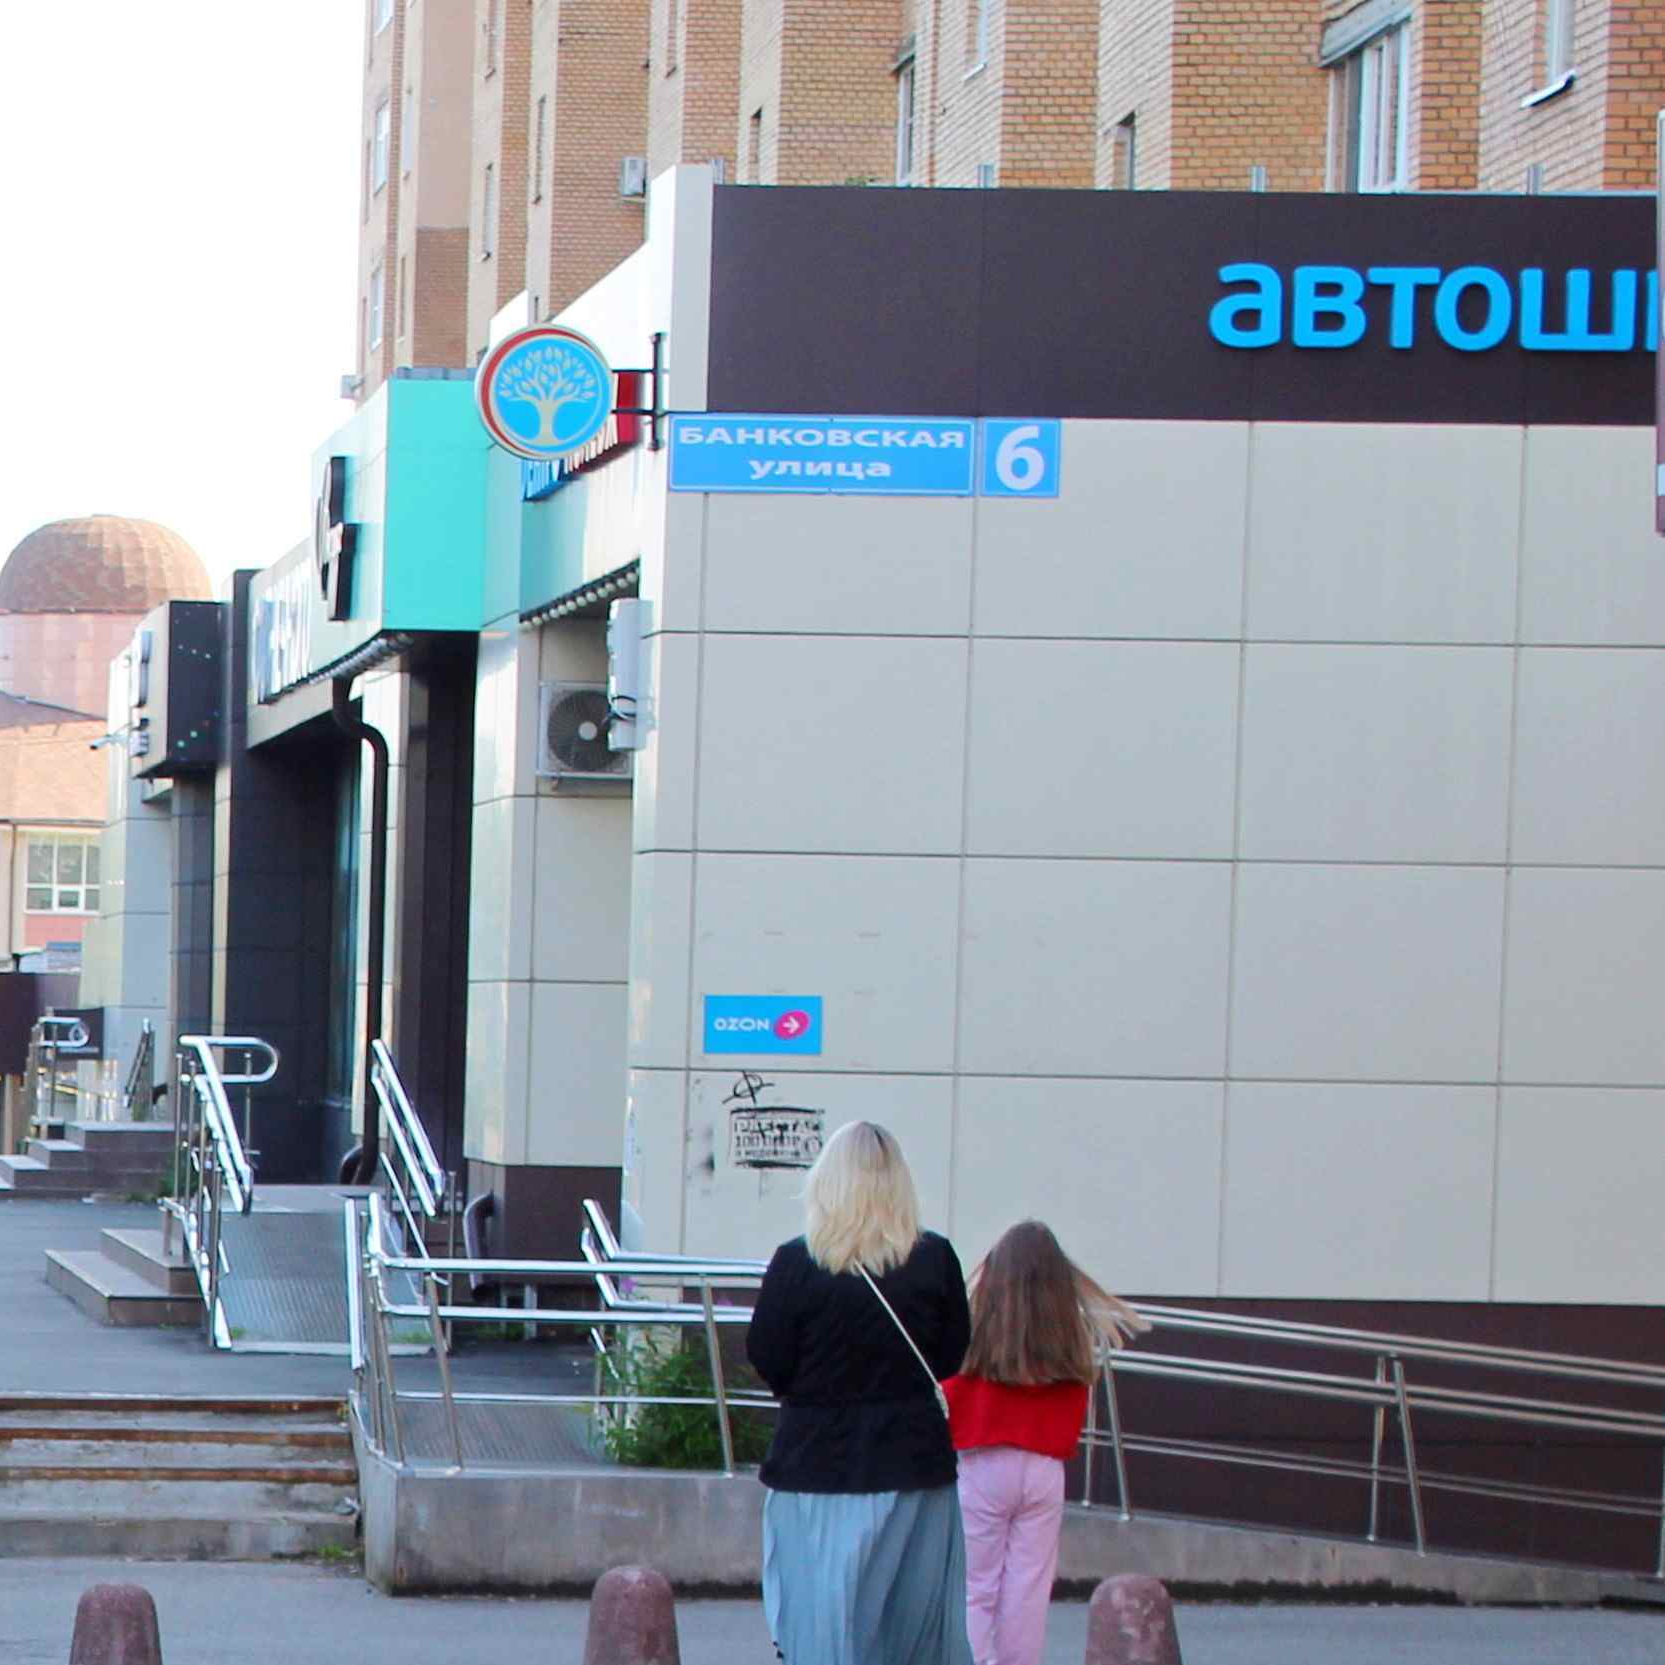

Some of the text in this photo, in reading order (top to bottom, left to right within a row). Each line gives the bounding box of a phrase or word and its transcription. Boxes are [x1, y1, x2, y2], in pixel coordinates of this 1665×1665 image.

[678, 426, 967, 449] БАНКОВСКАЯ
[994, 424, 1046, 491] 6
[748, 459, 892, 481] улица
[713, 1016, 770, 1032] OZON
